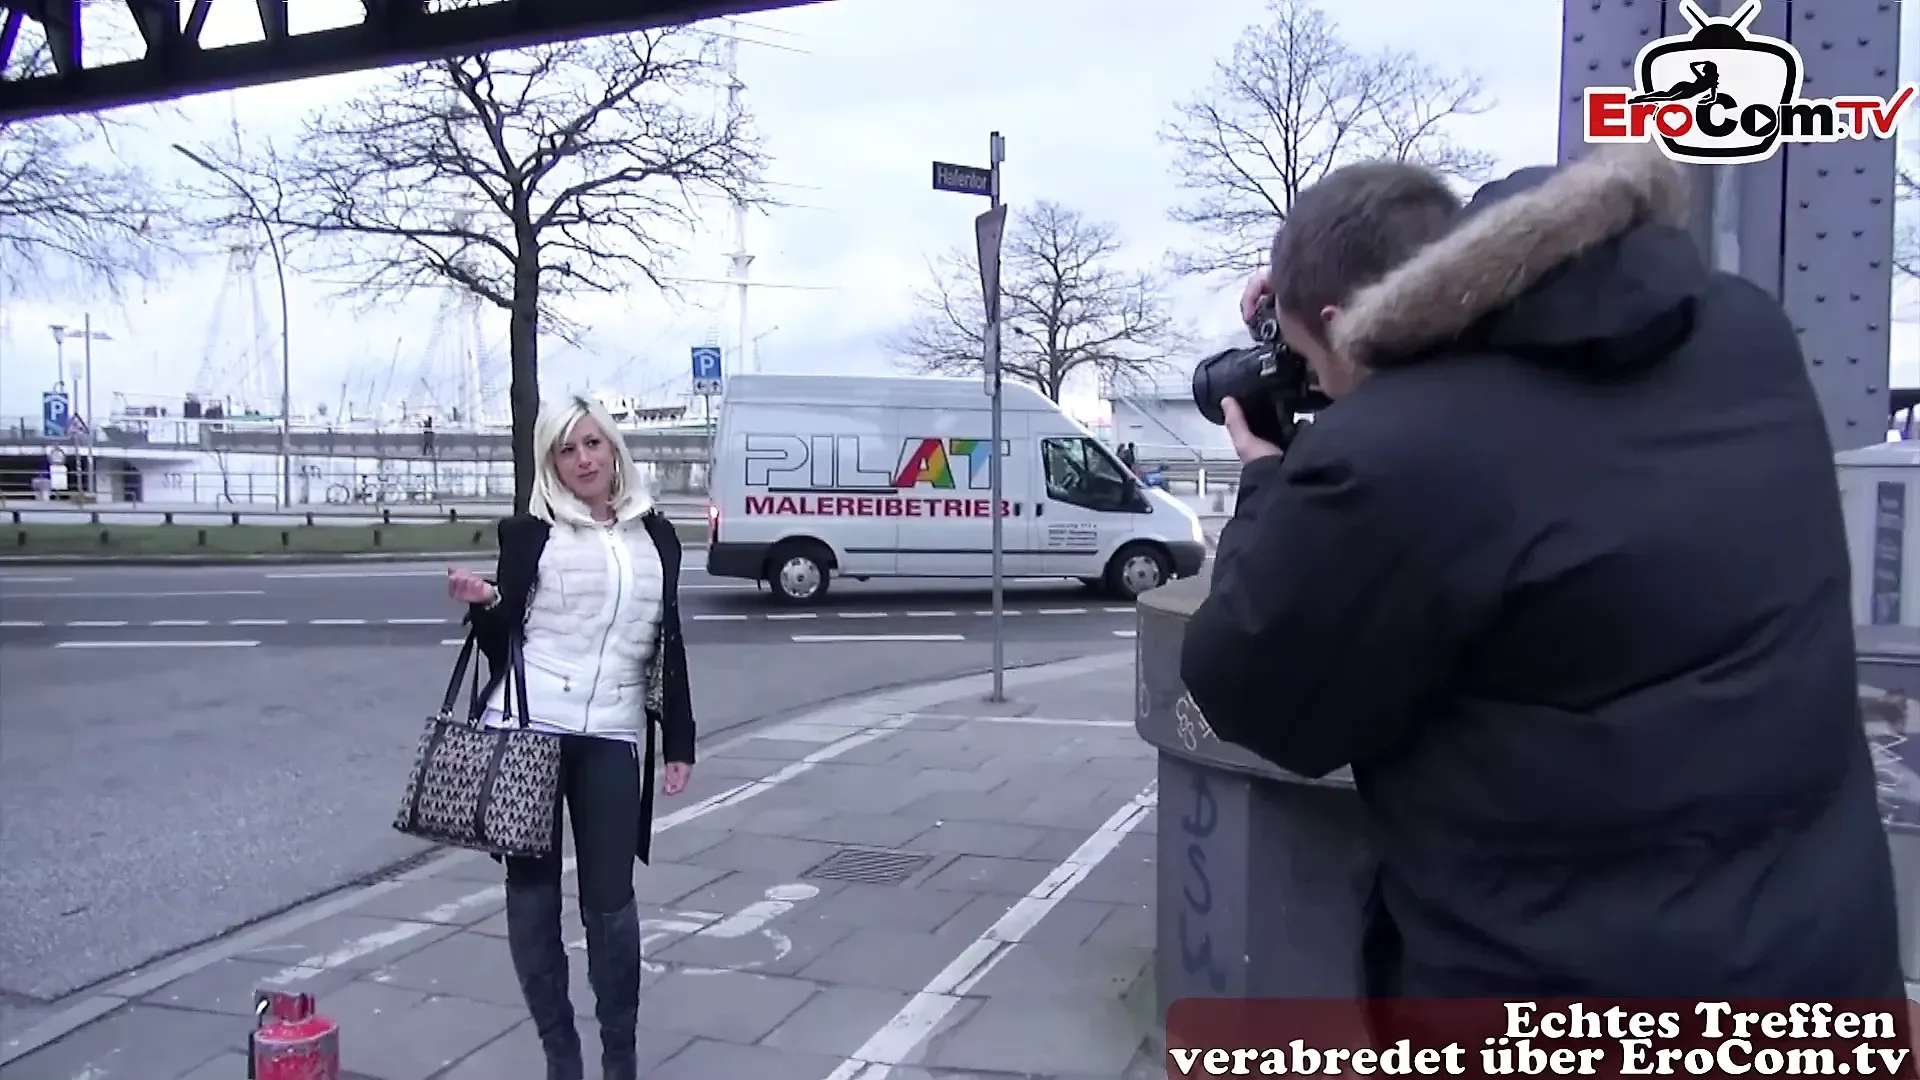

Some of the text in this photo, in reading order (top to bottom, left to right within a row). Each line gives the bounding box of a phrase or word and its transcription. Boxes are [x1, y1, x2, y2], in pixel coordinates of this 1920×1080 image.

[700, 354, 715, 377] P
[50, 400, 65, 421] P
[745, 434, 1011, 490] PILAT
